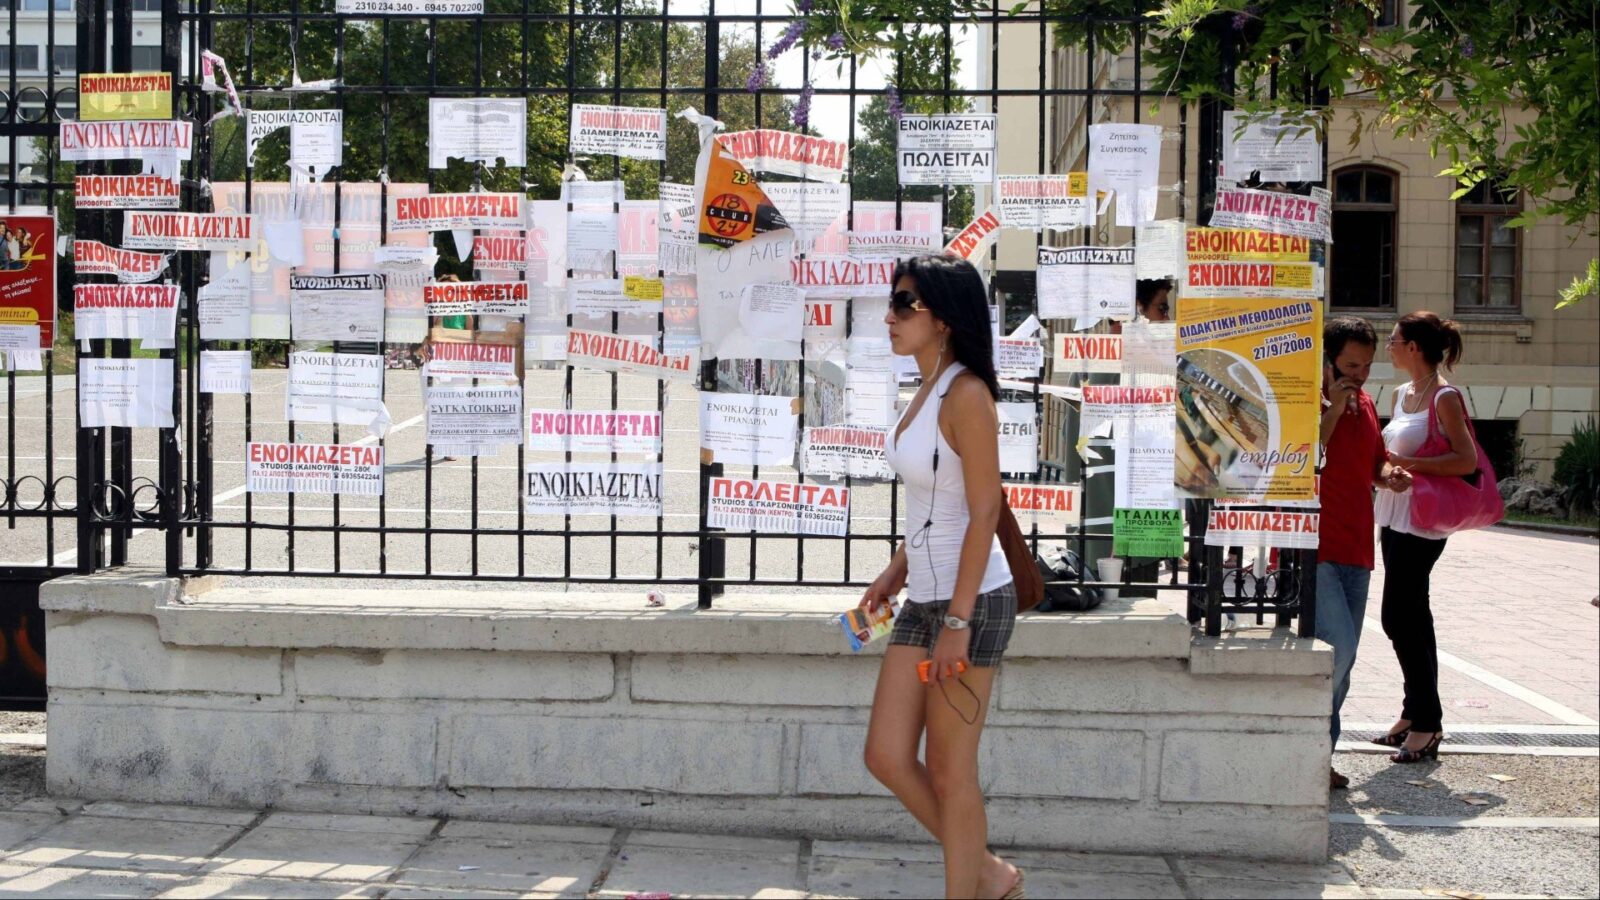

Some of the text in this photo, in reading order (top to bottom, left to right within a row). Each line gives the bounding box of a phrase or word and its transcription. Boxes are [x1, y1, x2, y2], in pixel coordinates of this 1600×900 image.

[355, 2, 376, 10] 2310
[378, 2, 413, 11] 234.340
[424, 3, 447, 12] 6945
[450, 3, 482, 12] 702200
[80, 75, 171, 93] ΕΝΟΙΚΙΑΖΕΤΑΙ
[251, 112, 341, 124] ΕΝΟΙΚΙΑΖΟΝΤΑΙ
[580, 111, 660, 131] ΕΝΟΙΚΙΑΖΟΝΤΑΙ
[900, 119, 993, 131] ΕΝΟΙΚΙΑΖΕΤΑΙ
[62, 122, 190, 150] ΕΝΟΙΚΙΑΖΕΤΑΙ
[580, 129, 659, 138] ΔΙΑΜΕΡΙΣΜΑΤΑ
[903, 152, 989, 167] ΠΩΛΕΙΤΑΙ
[732, 170, 749, 185] 23
[74, 176, 179, 197] ΕΝΟΙΚΙΑΖΕΤΑΙ
[397, 196, 518, 220] ΕΝΟΙΚΙΑΖΕΤΑΙ
[720, 194, 740, 209] 18
[709, 207, 748, 221] CLUB
[132, 214, 250, 238] ΕΝΟΙΚΙΑΖΕΤΑΙ
[717, 220, 739, 233] 24
[848, 235, 930, 246] ΕΝΟΙΚΙΑΖΕΤΑΙ
[946, 211, 1001, 260] ΖΕΤΑΙ
[1186, 231, 1307, 253] ΕΝΟΙΚΙΑΖΕΤΑΙ
[1039, 249, 1133, 265] ΕΝΟΙΚΙΑΖΕΤΑΙ
[75, 285, 177, 308] ΕΝΟΙΚΙΑΖΕΤΑΙ
[424, 283, 528, 303] ΕΝΟΙΚΙΑΖΕΤΑΙ
[1180, 316, 1237, 338] ΔΙΔΑΚΤΙΚΗ
[1239, 302, 1313, 326] ΜΕΘΟΔΟΛΟΓΙΑ
[1265, 333, 1296, 344] ΣΑΒΒΑΤΟ
[432, 342, 512, 363] ΝΟΙΚΙΑΖΕΤΑΙ
[1253, 337, 1312, 360] 27/9/2008
[293, 356, 379, 368] ΕΝΟΙΚΙΑΖΕΤΑΙ
[431, 404, 516, 413] ΣΥΓΚΑΤΟΙΚΗΣΗ
[707, 402, 778, 416] ΕΝΟΙΚΙΑΖΕΤΑΙ
[531, 413, 660, 436] ΕΝΟΙΚΙΑΖΕΤΑΙ
[723, 415, 767, 426] ΤΡΙΑΝΔΡΙΑ
[810, 429, 888, 449] ΕΝΟΙΚΙΑΖΟΝΤΑ
[251, 443, 380, 465] ΕΝΟΙΚΙΑΖΕΤΑΙ
[810, 445, 885, 457] ΔΙΑΜΕΡΙΣΜΑΤΑ
[1240, 443, 1308, 474] employ
[295, 464, 342, 472] (ΚΑΙΝΟΥΡΙΑ)
[528, 472, 661, 499] ΕΝΟΙΚΙΑΖΕΤΑΙ
[713, 479, 848, 508] ΠΩΛΕΙΤΑΙ
[712, 498, 745, 506] STUDIOS
[756, 501, 814, 512] ΓΚΑΡΣΟΝΙΕΡΕΣ
[804, 513, 844, 522] 6936542244
[1116, 510, 1180, 520] ΙΤΑΛΙΚΑ
[1209, 512, 1317, 533] ΕΝΟΙΚΙΑΖΕΤΑΙ
